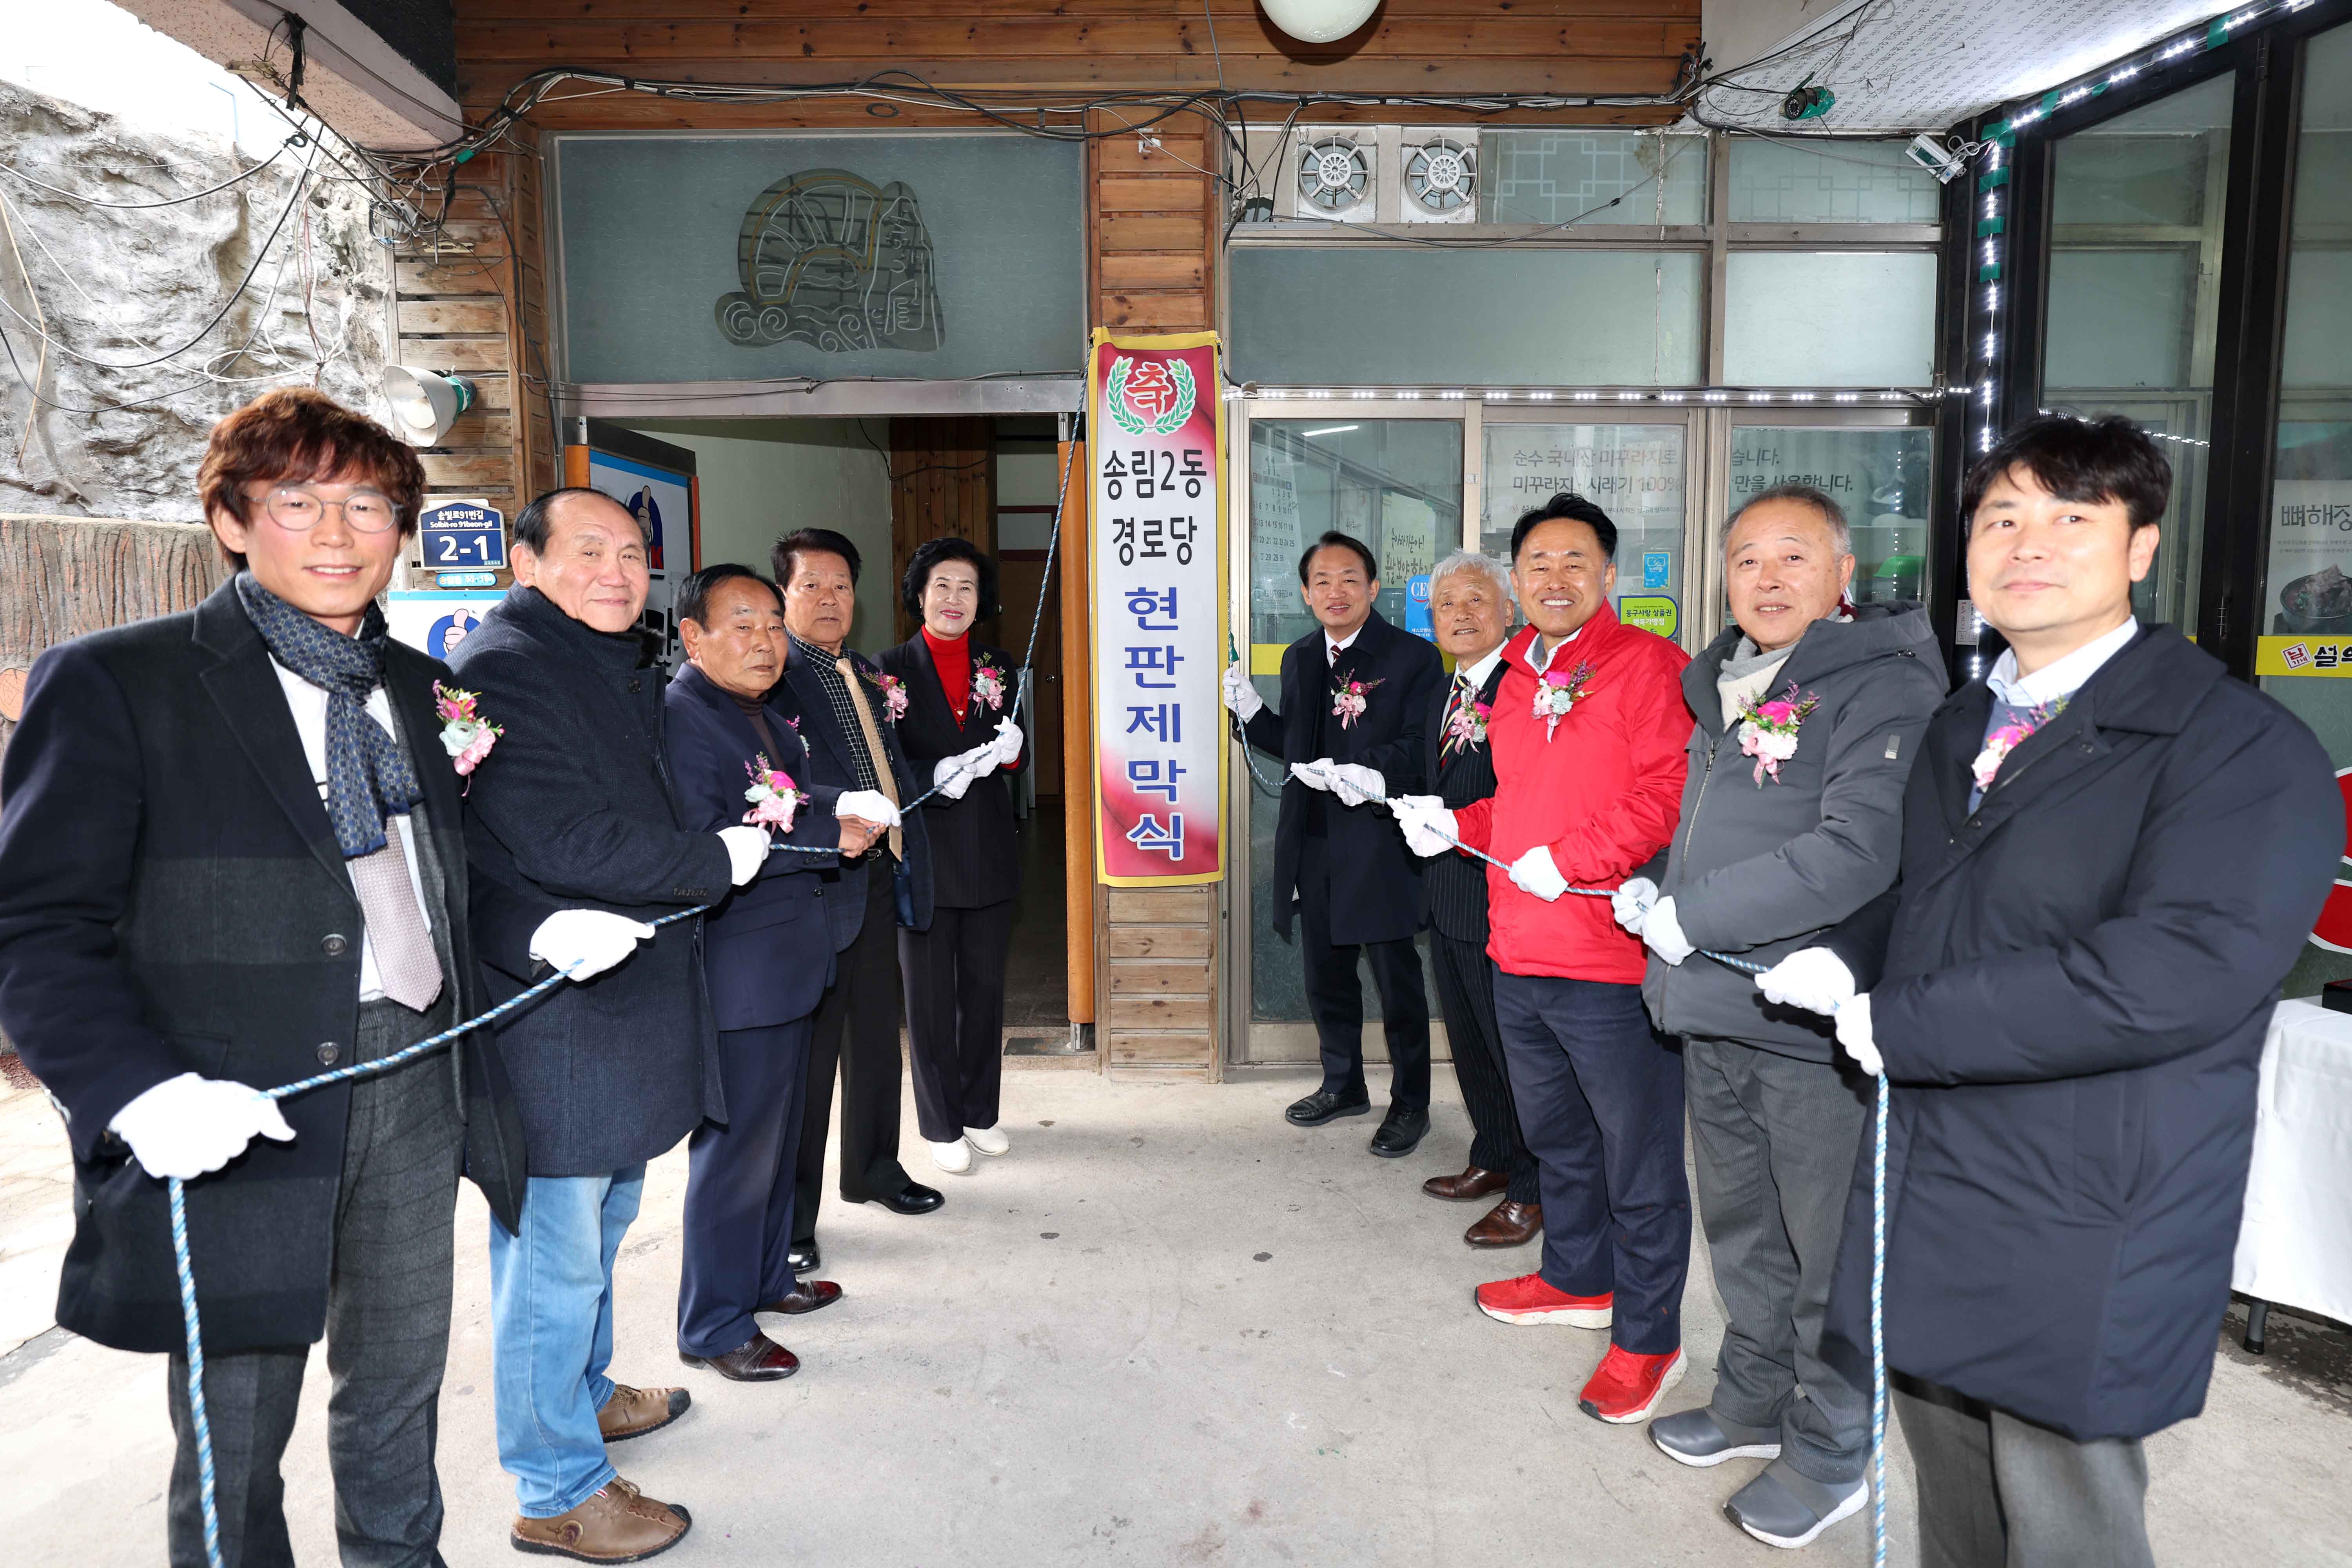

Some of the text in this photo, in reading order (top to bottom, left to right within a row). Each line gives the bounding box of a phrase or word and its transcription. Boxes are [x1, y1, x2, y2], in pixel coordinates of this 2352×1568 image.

[1126, 364, 1170, 415] 축
[1514, 450, 1543, 468] 순수
[1732, 448, 1780, 466] 습니다.
[1103, 450, 1207, 500] 송림2동
[1731, 475, 1766, 493] 만을
[458, 520, 493, 528] 91beon-gil
[439, 535, 488, 561] 2-1
[1112, 516, 1197, 566] 경로당
[1411, 582, 1430, 596] CE
[1626, 609, 1672, 617] 동구사랑 상품권
[1124, 586, 1187, 859] 현판제막식
